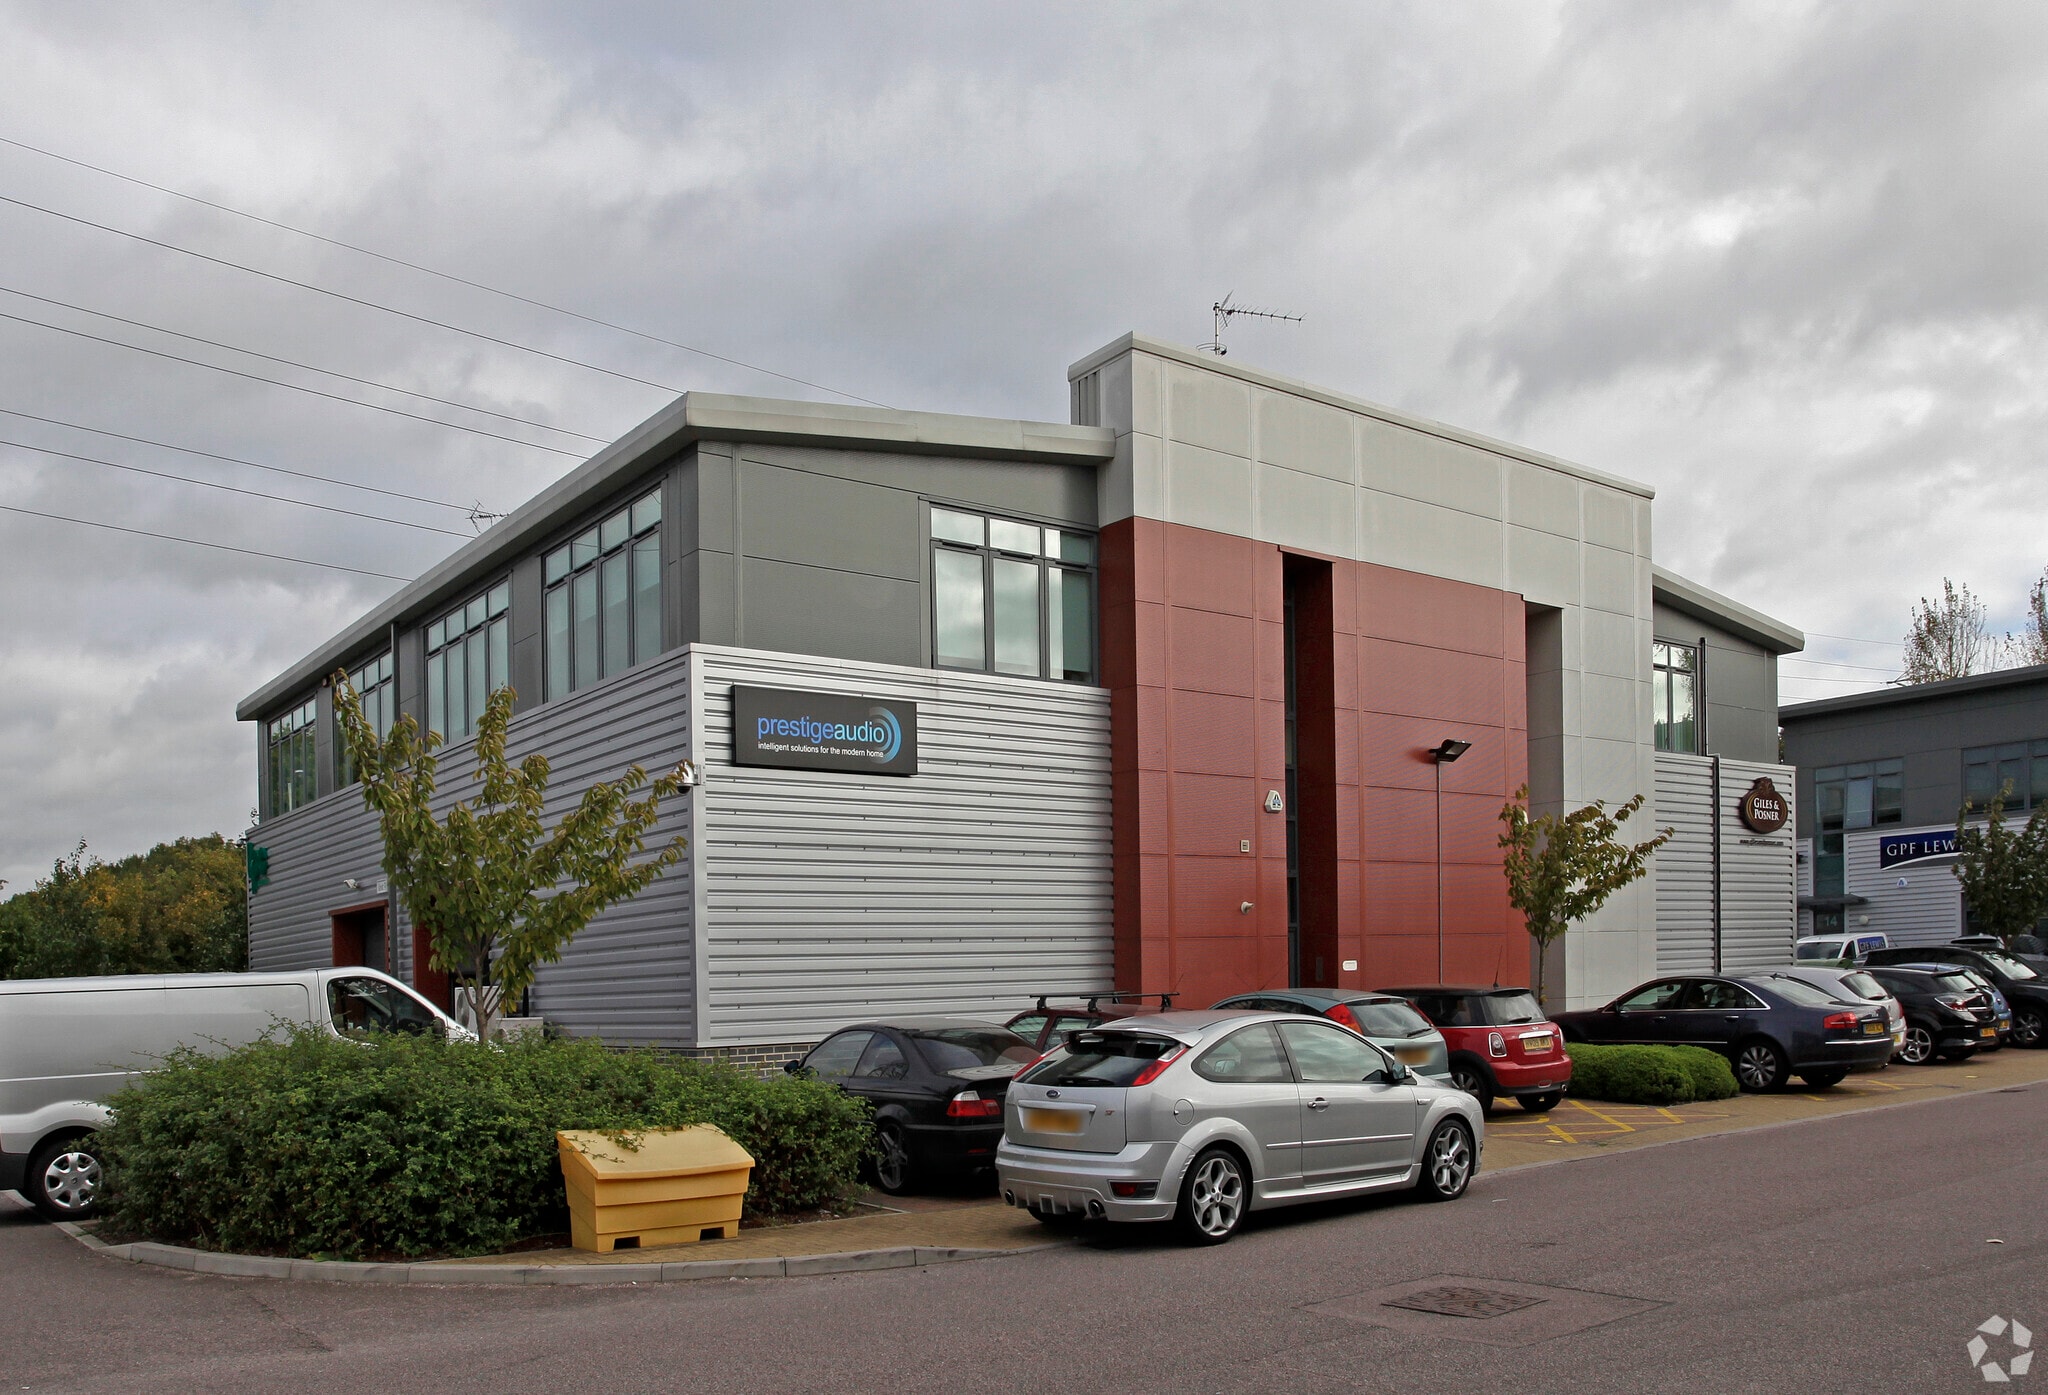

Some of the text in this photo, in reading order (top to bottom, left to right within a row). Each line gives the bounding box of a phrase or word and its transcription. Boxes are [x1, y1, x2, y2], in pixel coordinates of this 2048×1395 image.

[757, 715, 885, 744] prestigeaudio
[757, 741, 884, 759] intelligent solutions for the modern home
[1773, 800, 1780, 811] &
[1754, 808, 1780, 821] POSNER
[1886, 839, 1964, 857] GPF LEW
[1826, 915, 1838, 927] 14
